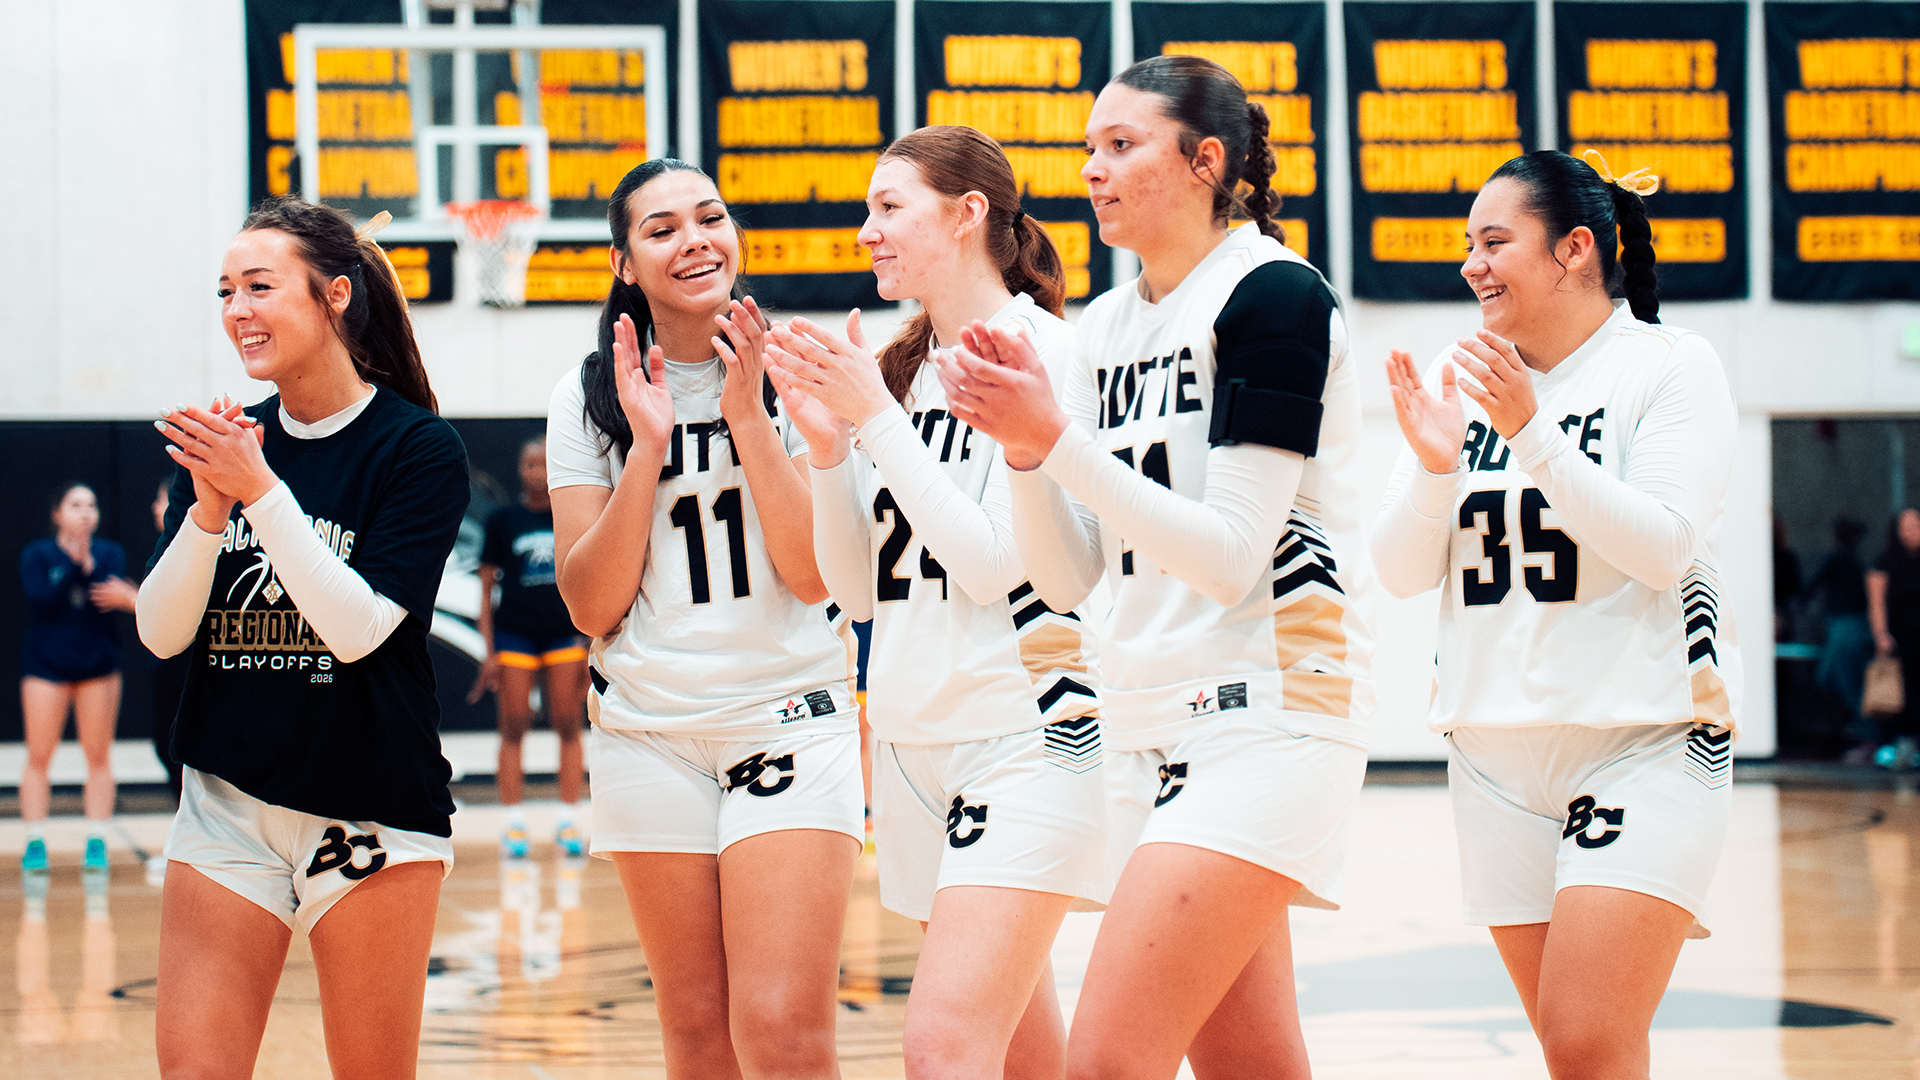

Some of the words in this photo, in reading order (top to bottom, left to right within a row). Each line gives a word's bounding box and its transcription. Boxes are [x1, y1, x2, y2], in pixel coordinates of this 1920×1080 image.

[668, 485, 752, 606] 11
[1459, 486, 1580, 609] 35
[209, 654, 333, 670] PLAYOFFS
[310, 673, 334, 683] 2026
[723, 751, 797, 799] BC
[1562, 793, 1627, 851] BC
[305, 824, 389, 883] BC
